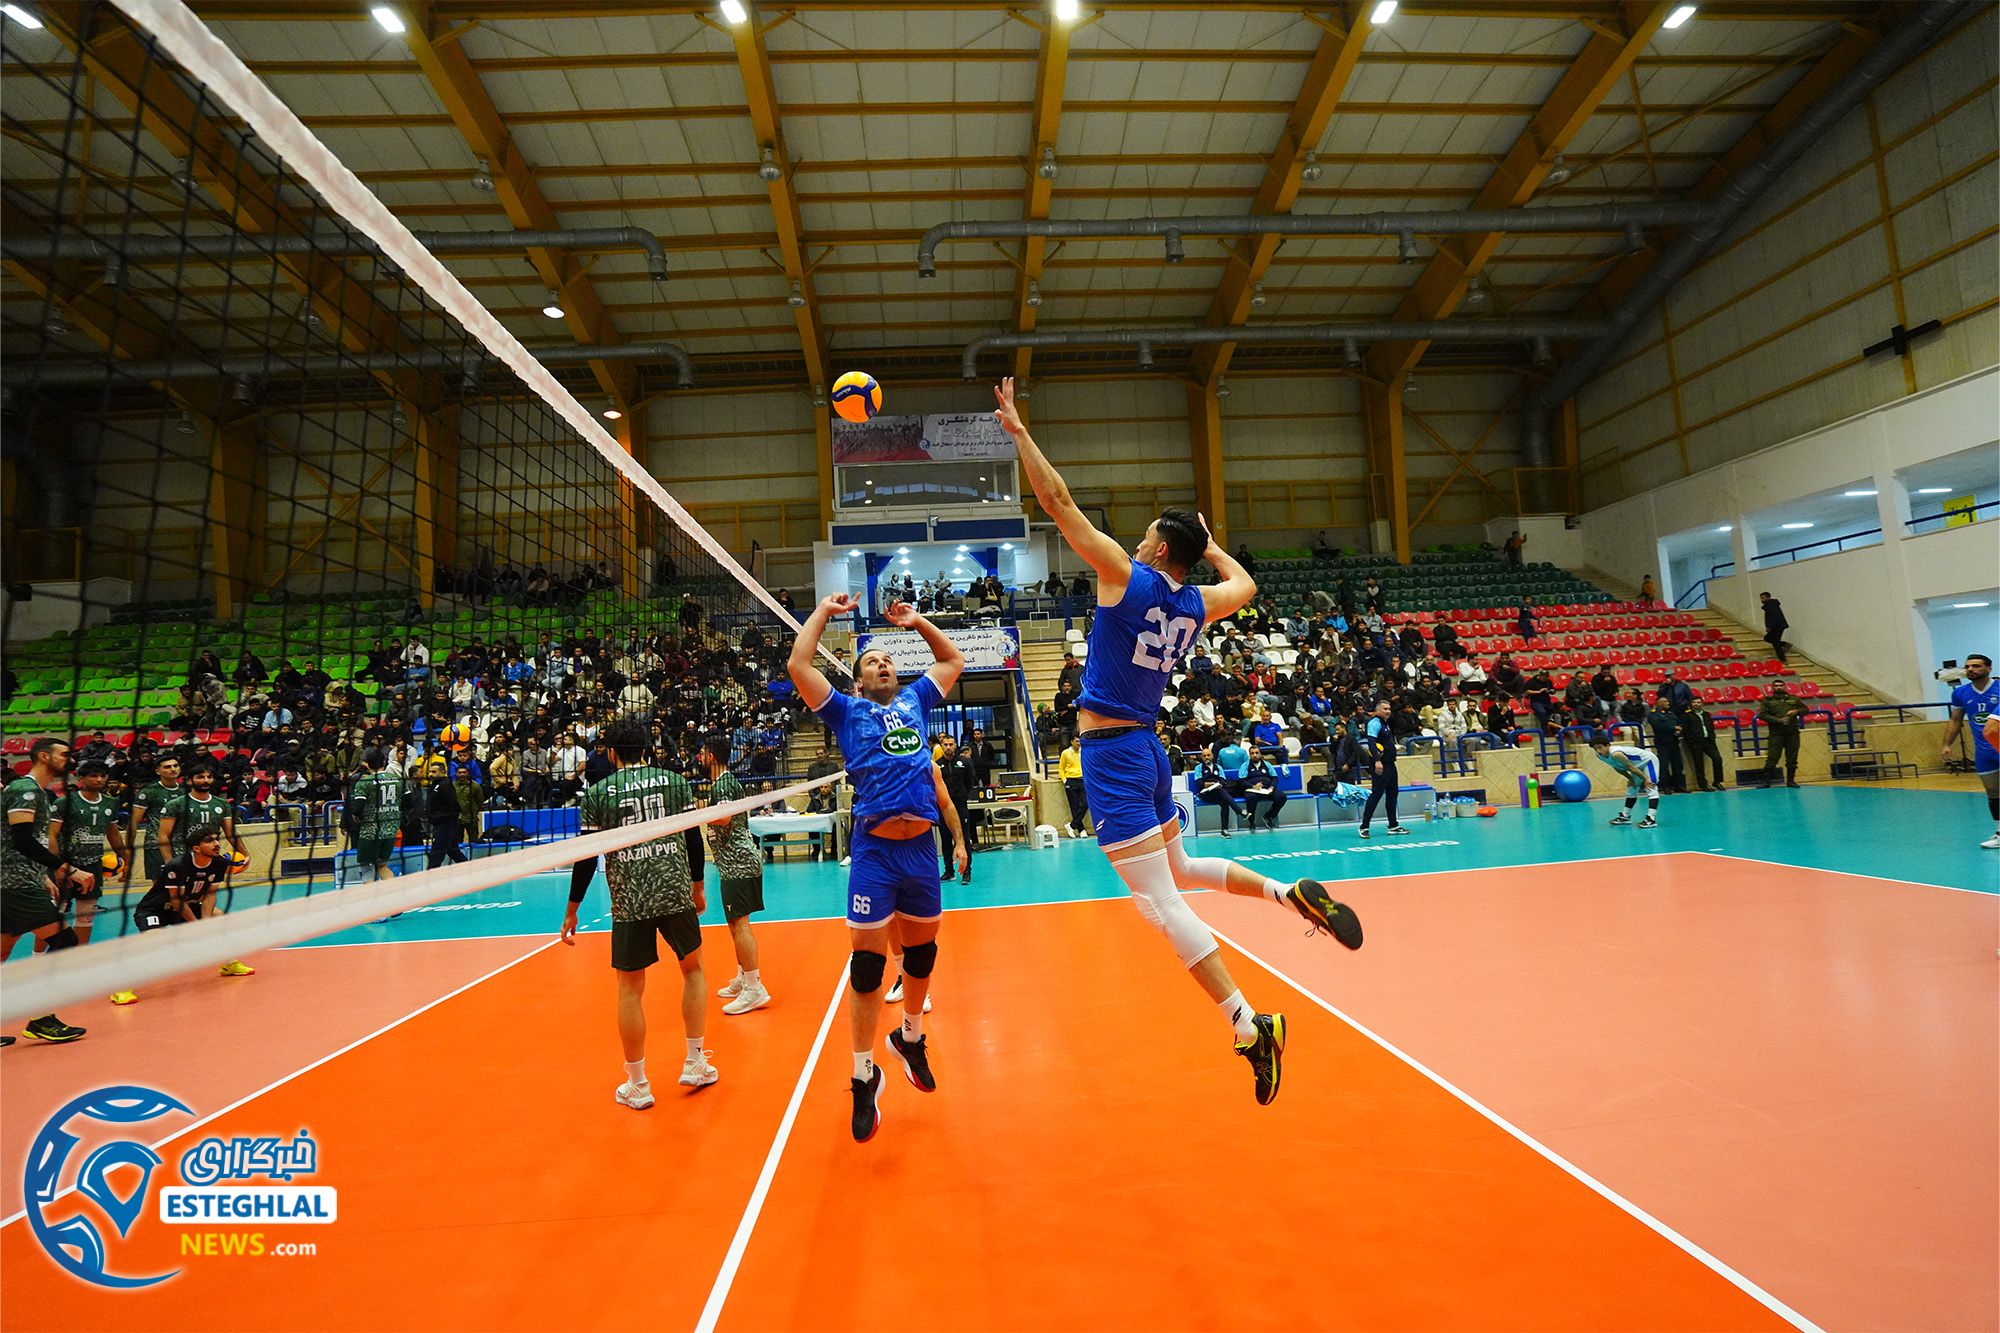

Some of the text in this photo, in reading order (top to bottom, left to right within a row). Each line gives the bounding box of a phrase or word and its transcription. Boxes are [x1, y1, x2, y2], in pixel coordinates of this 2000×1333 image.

[937, 415, 977, 426] گردشگری
[1131, 606, 1197, 673] 20
[1977, 702, 1986, 712] 17
[883, 710, 905, 732] 66
[380, 784, 396, 805] 14
[986, 788, 993, 800] 0
[92, 813, 97, 826] 1
[200, 811, 210, 824] 11
[618, 841, 679, 863] RAZIN PVB
[1232, 839, 1461, 862] GONBAD KAVOUS
[852, 893, 872, 915] 66
[146, 916, 160, 926] 10
